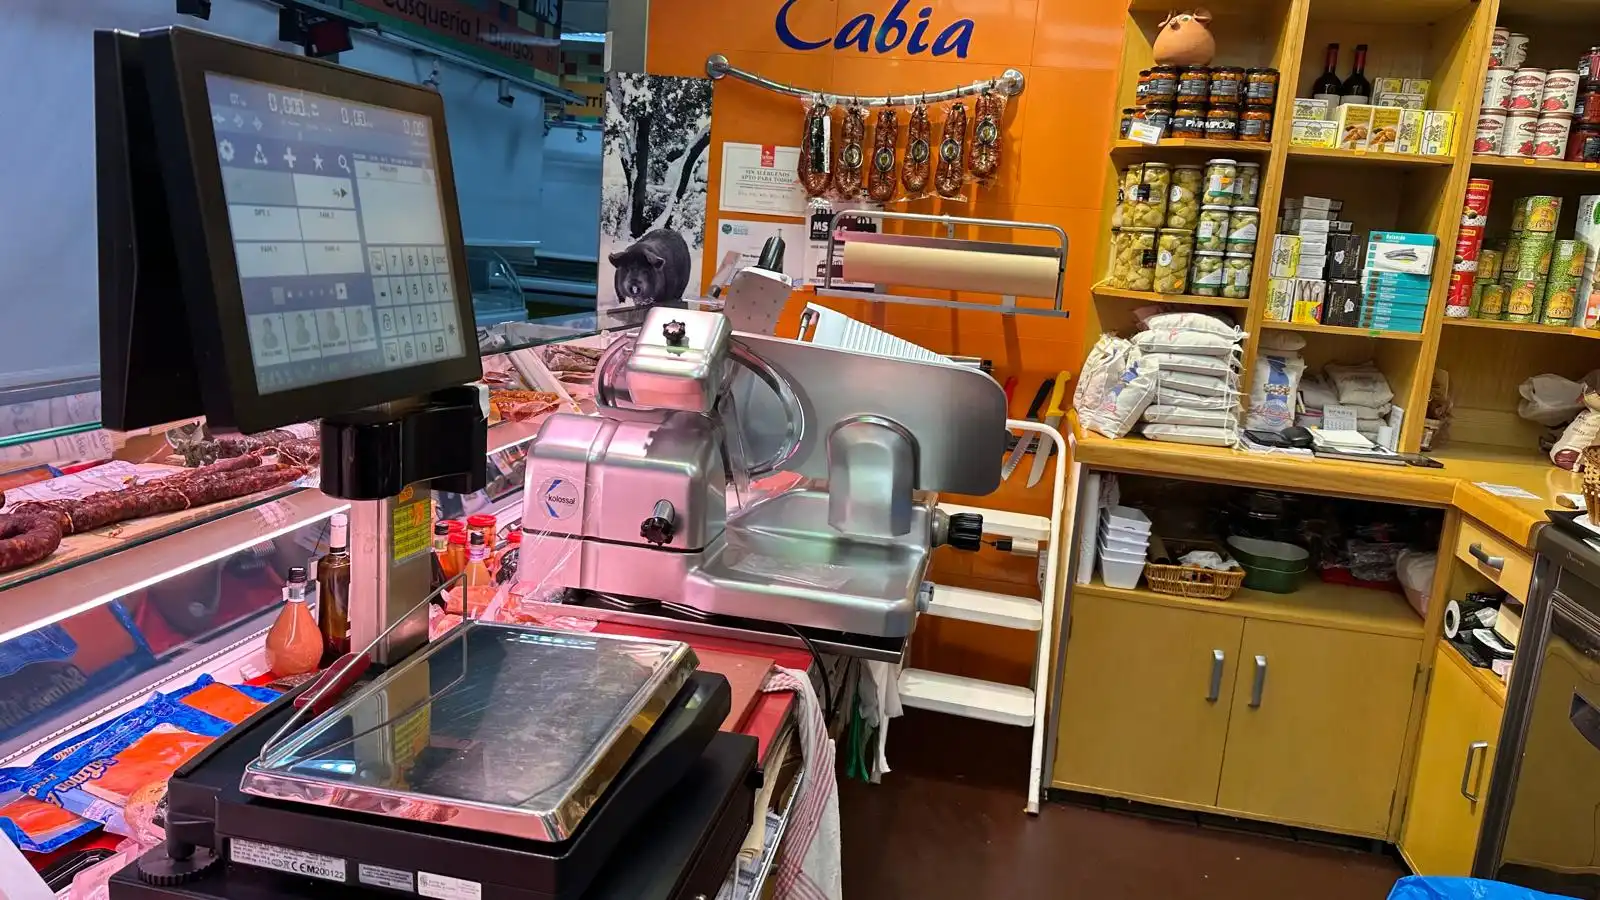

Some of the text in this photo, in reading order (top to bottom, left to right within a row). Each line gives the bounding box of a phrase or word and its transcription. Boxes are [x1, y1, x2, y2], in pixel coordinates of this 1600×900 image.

[775, 0, 975, 58] Cabia
[813, 221, 829, 232] MS
[392, 255, 397, 267] 7
[397, 285, 402, 296] 4
[418, 314, 423, 325] 2
[433, 312, 438, 323] 3
[421, 342, 427, 353] 0
[548, 494, 575, 505] kolossal
